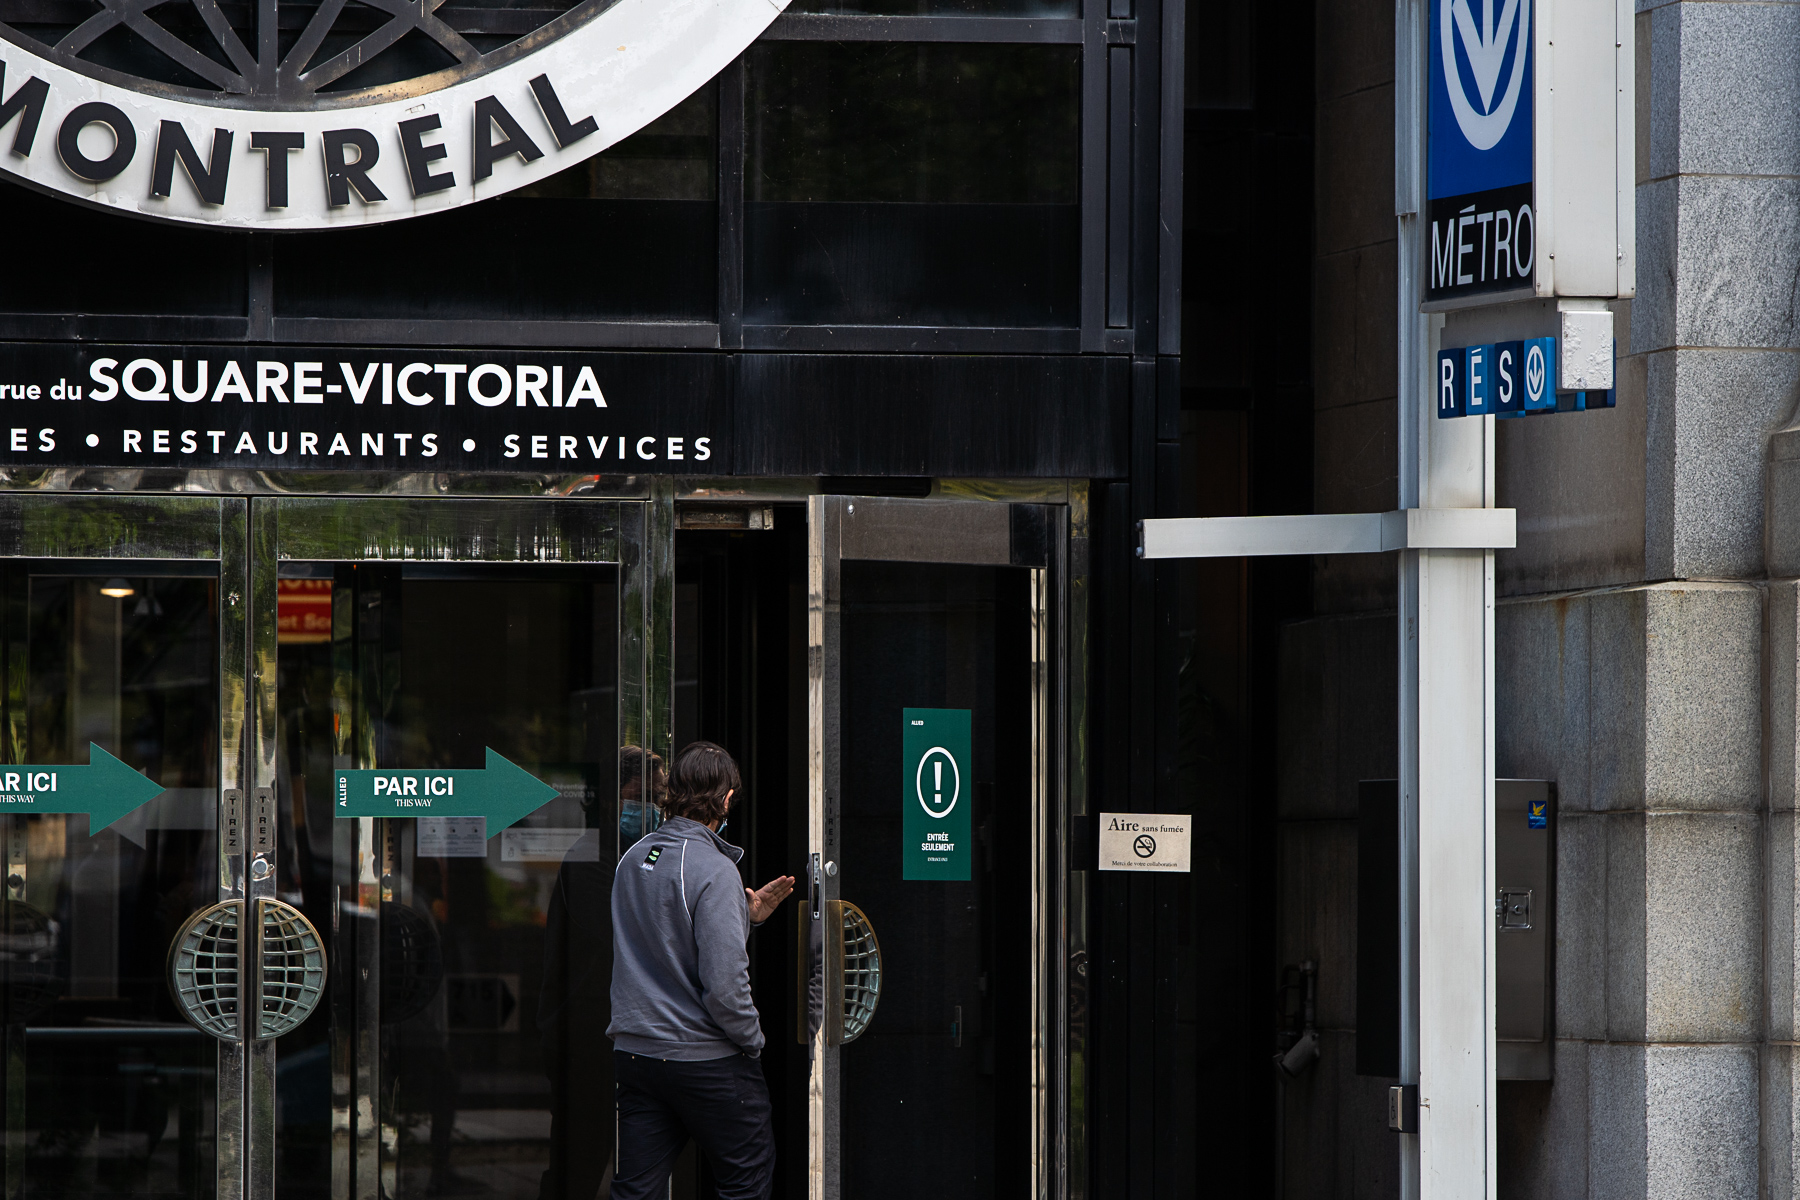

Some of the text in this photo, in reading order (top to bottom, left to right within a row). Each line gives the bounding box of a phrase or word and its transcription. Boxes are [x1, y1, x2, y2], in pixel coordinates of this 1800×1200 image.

[1432, 204, 1534, 289] MÉTRO
[0, 358, 607, 407] rue du SQUARE-VICTORIA
[124, 430, 438, 457] RESTAURANTS
[504, 434, 711, 461] SERVICES
[27, 773, 57, 792] ICI
[374, 777, 453, 796] PAR ICI
[16, 795, 35, 803] WAY
[395, 799, 432, 807] THIS WAY
[229, 796, 237, 847] TIREZ
[259, 795, 267, 845] TIREZ
[1108, 817, 1139, 832] Aire
[1160, 825, 1184, 833] fumée
[927, 831, 949, 842] ENTRÉE
[922, 842, 954, 852] SEULEMENT
